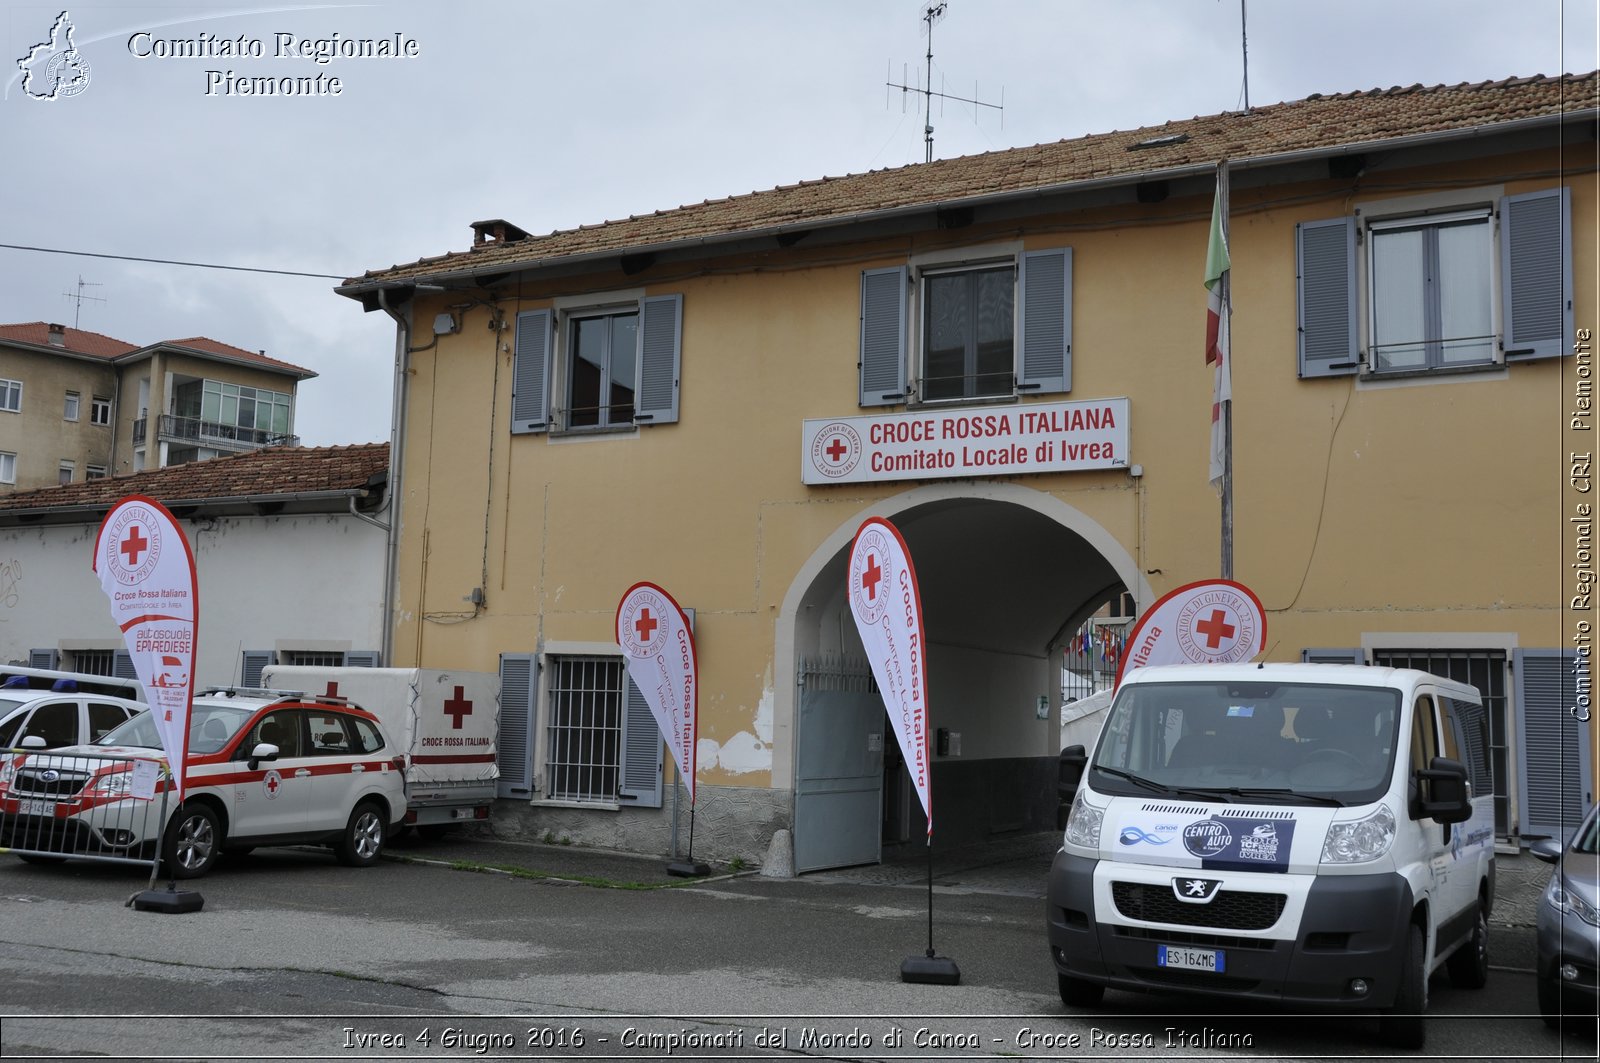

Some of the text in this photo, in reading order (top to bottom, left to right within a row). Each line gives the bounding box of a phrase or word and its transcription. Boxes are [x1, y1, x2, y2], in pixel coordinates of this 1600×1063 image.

[870, 407, 1116, 444] CROCE ROSSA ITALIANA
[814, 425, 840, 457] CONVENZIONE
[847, 429, 860, 454] GINEVRA
[871, 440, 1114, 473] Comitato Locale di Ivrea
[114, 588, 187, 601] Croce Rossa Italiana
[1193, 596, 1204, 608] DI
[1204, 592, 1242, 611] GINEVRA
[1240, 611, 1251, 622] 22
[137, 627, 191, 640] autoscuola
[1179, 606, 1206, 664] CONVENZIONE
[136, 640, 190, 653] EPOREDIESE
[1234, 625, 1252, 658] AGOSTO
[900, 569, 925, 788] Croce Rossa Italiana
[677, 629, 692, 773] Croce Rossa Italiana
[421, 737, 490, 747] CROCE ROSSA ITALIANA
[1184, 825, 1223, 838] CENTRO
[1207, 834, 1233, 847] AUTO
[1240, 835, 1279, 847] 2016
[1239, 851, 1277, 862] IVREA
